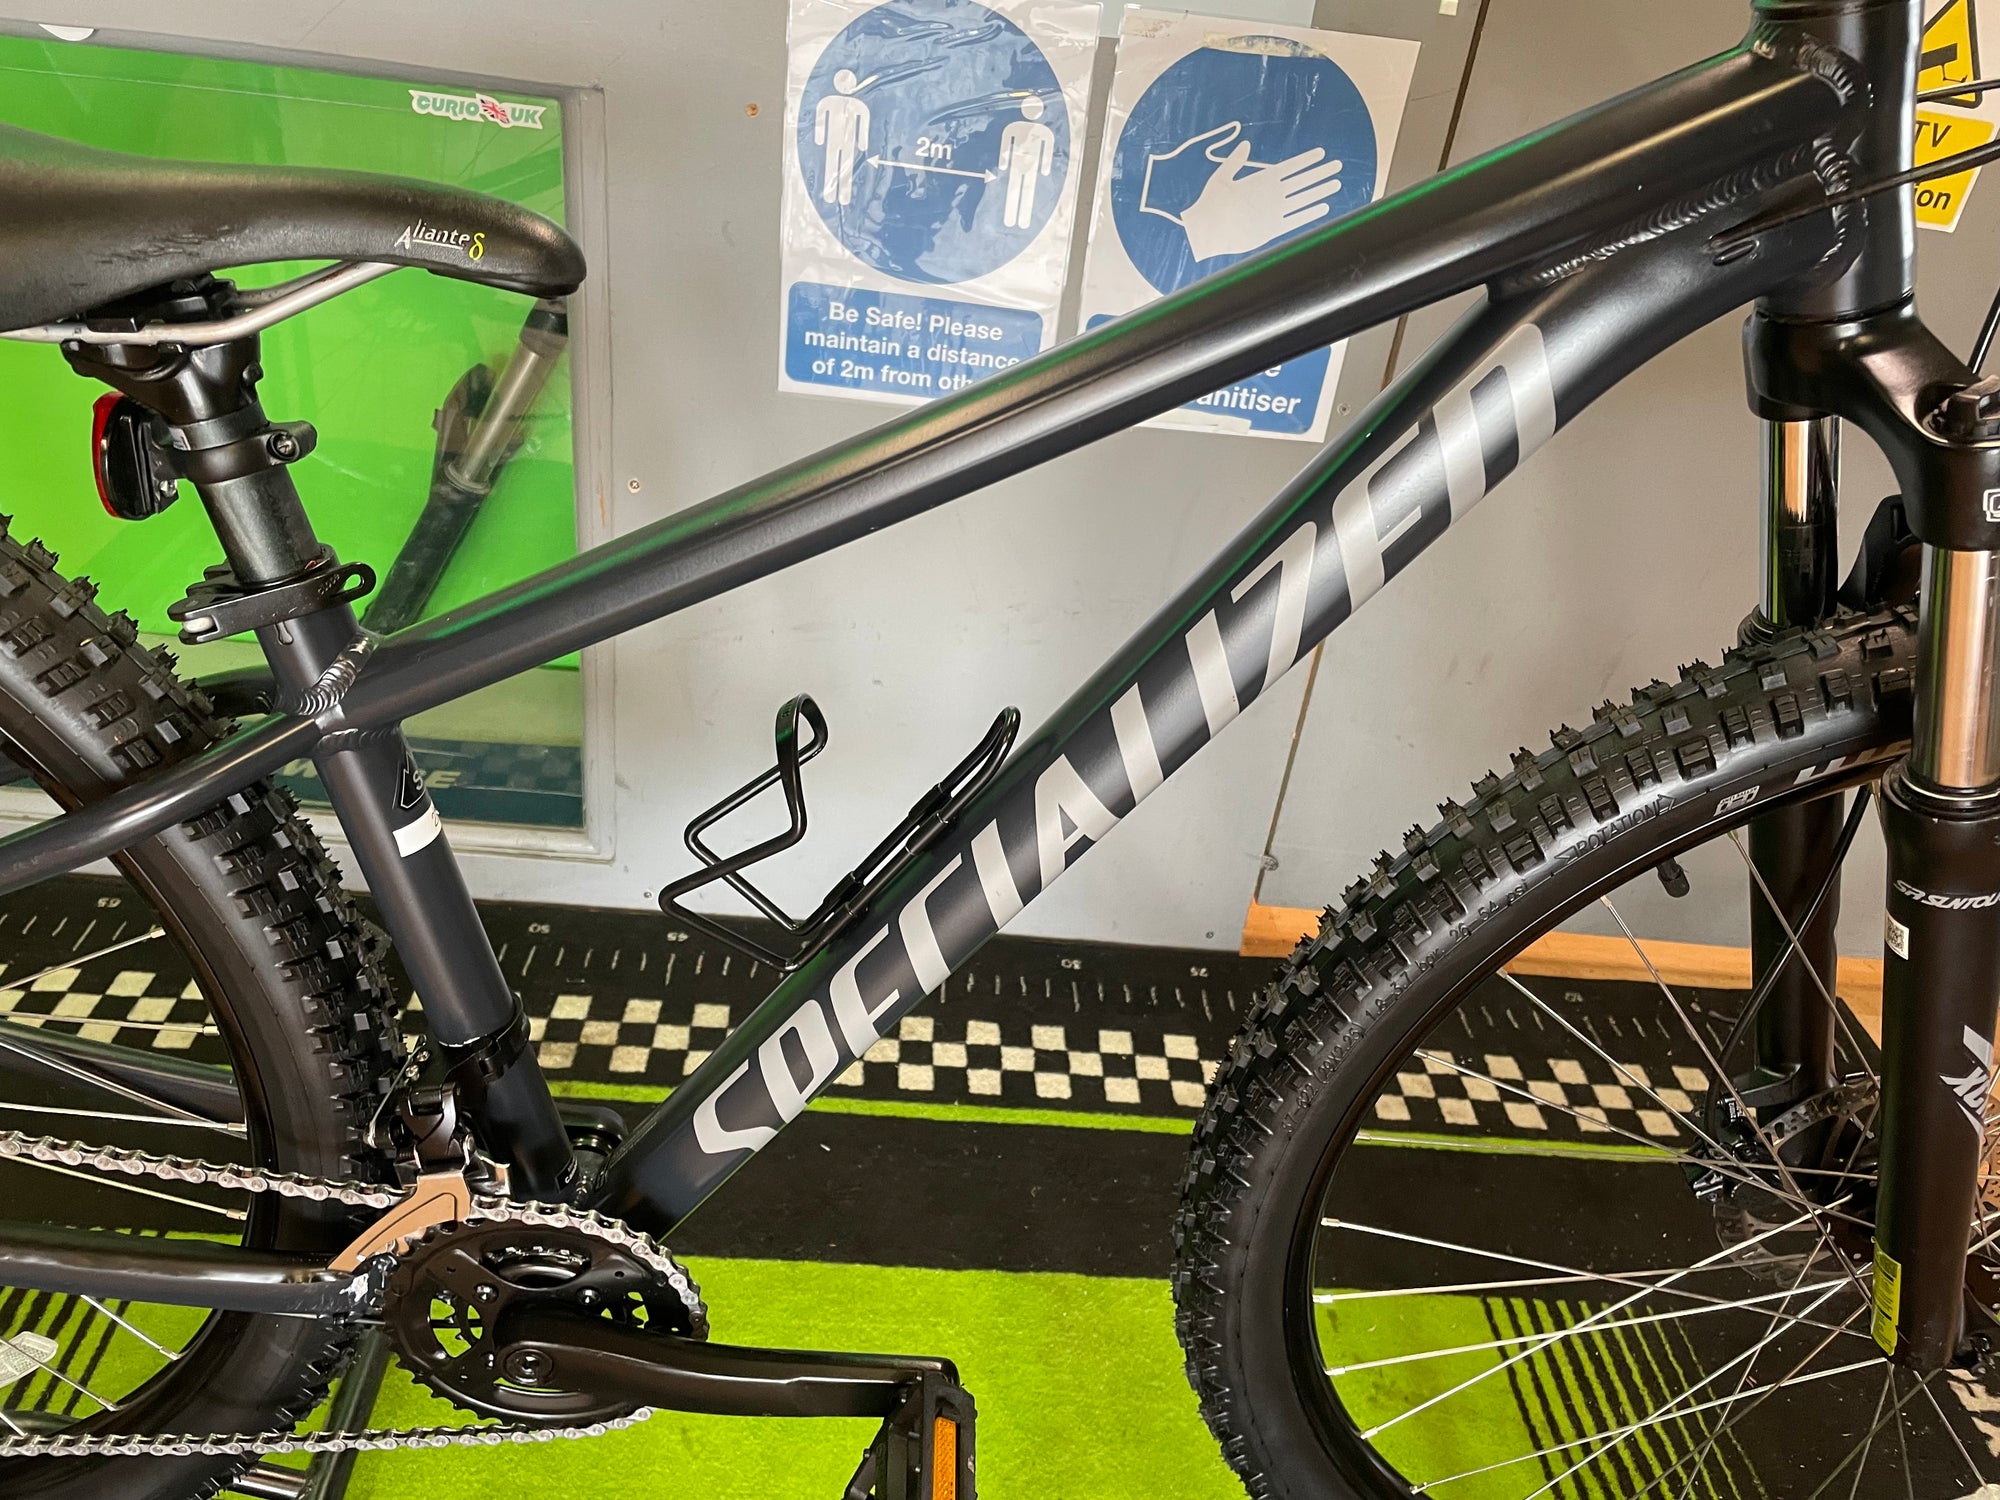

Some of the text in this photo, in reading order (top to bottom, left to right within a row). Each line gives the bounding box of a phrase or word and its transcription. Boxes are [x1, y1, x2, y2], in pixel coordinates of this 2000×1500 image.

[416, 95, 538, 125] CURIO UK
[915, 136, 953, 161] 2m
[393, 218, 470, 250] Aliante
[829, 301, 1003, 342] Be Safe! Please
[804, 330, 1019, 371] maintain a distance
[811, 359, 835, 377] of
[839, 360, 875, 381] 2m
[880, 364, 932, 389] from
[1574, 802, 1661, 857] ROTATION
[1505, 878, 1529, 908] psi
